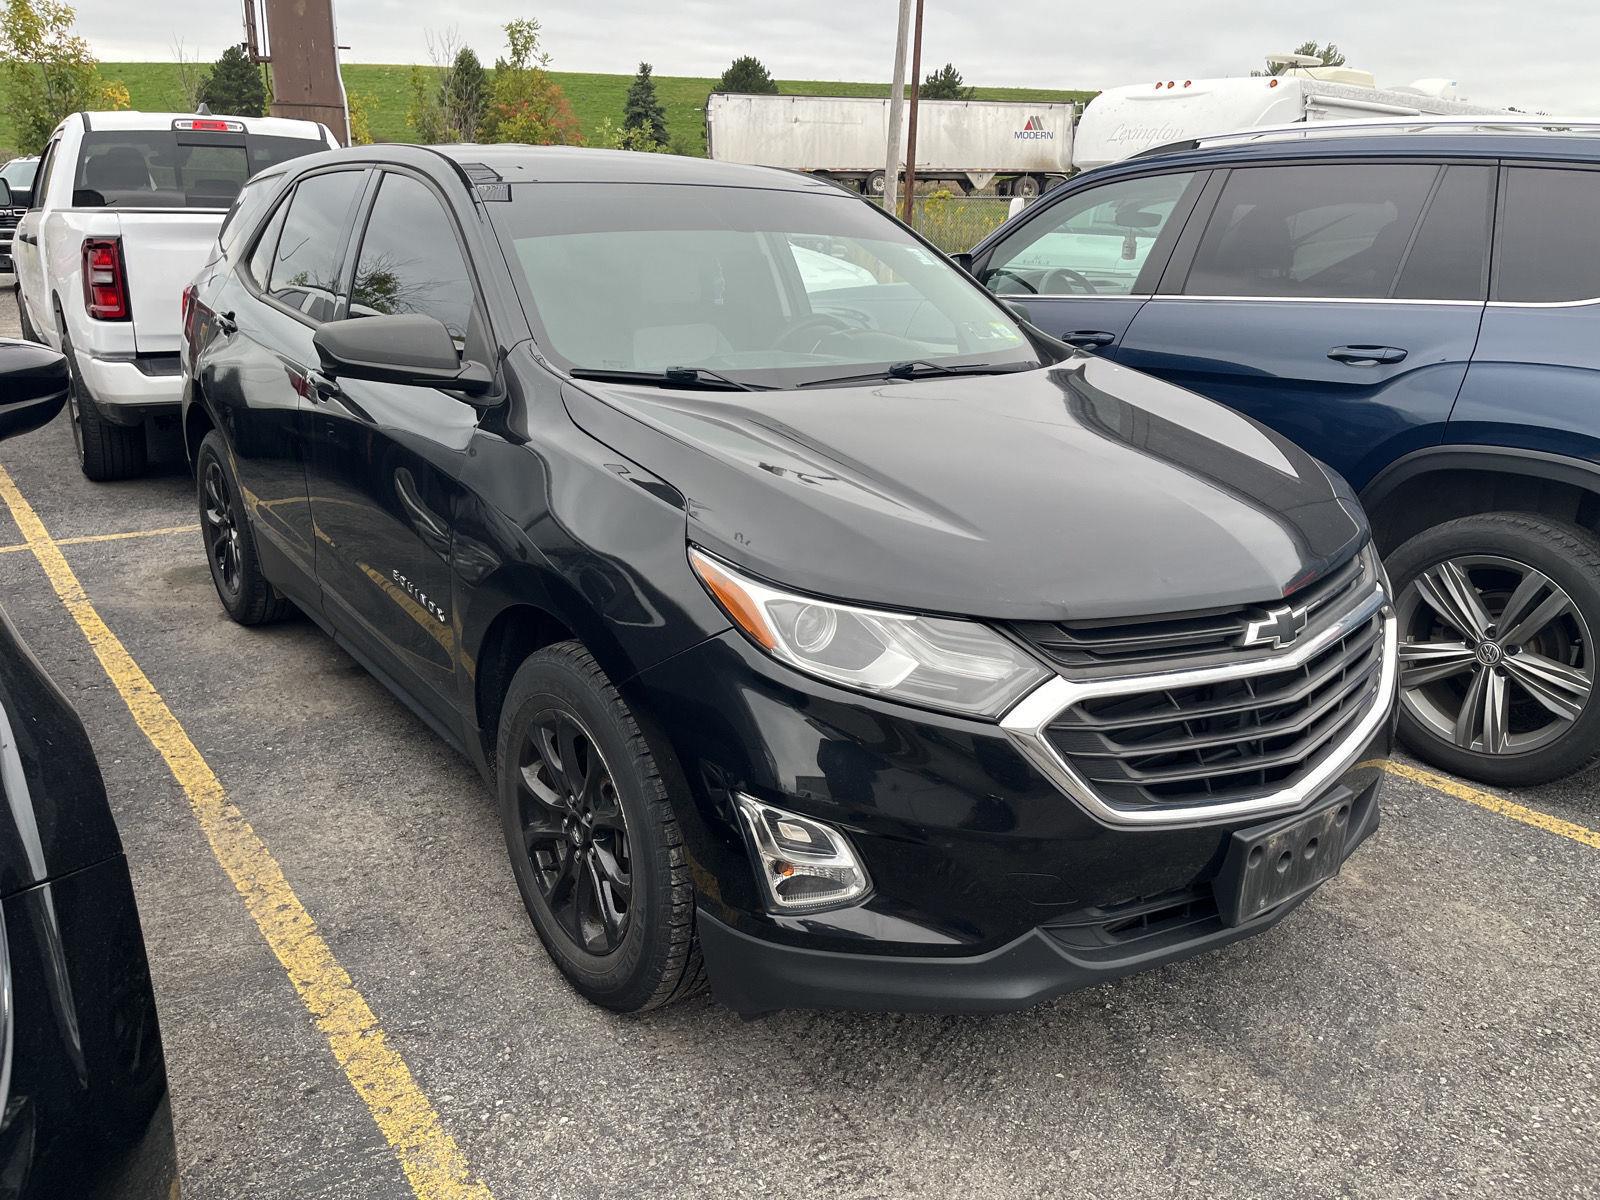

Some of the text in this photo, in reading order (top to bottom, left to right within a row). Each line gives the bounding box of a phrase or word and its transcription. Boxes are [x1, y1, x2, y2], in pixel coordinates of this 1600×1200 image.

[1014, 131, 1054, 140] MODERN
[1106, 121, 1184, 148] Lexington
[392, 569, 446, 622] EQUINOX
